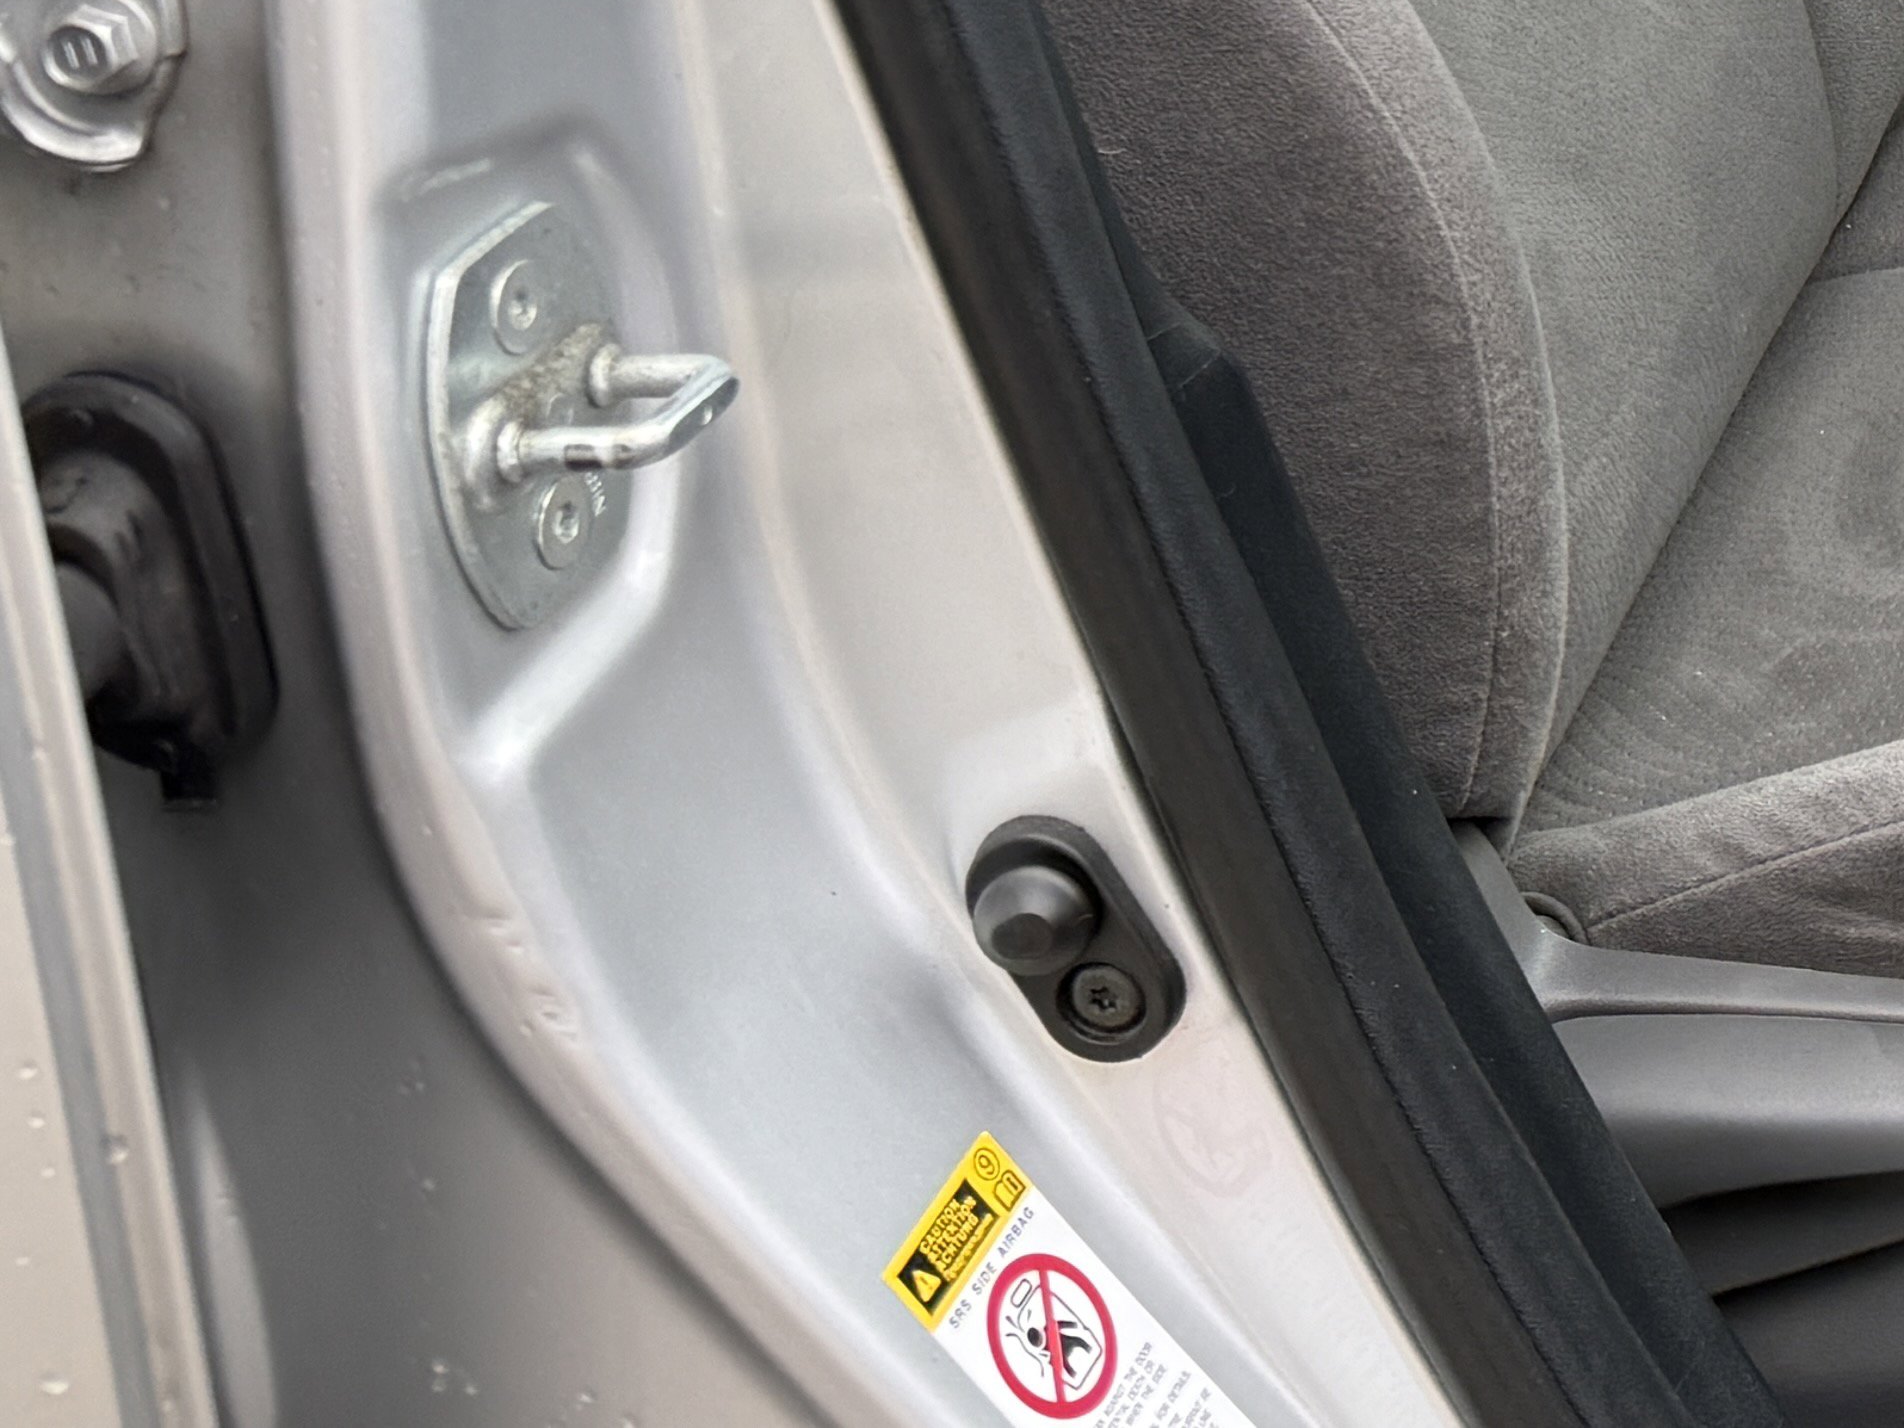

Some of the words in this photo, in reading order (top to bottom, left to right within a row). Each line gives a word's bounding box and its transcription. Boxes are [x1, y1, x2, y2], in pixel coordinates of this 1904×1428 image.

[978, 1154, 996, 1176] 9
[919, 1198, 961, 1256] CAUTION
[928, 1195, 978, 1263] ATTENTION
[936, 1213, 979, 1270] ACHTUNG
[949, 1299, 973, 1329] SRS
[972, 1261, 997, 1295] SIDE
[997, 1205, 1035, 1257] AIRBAG
